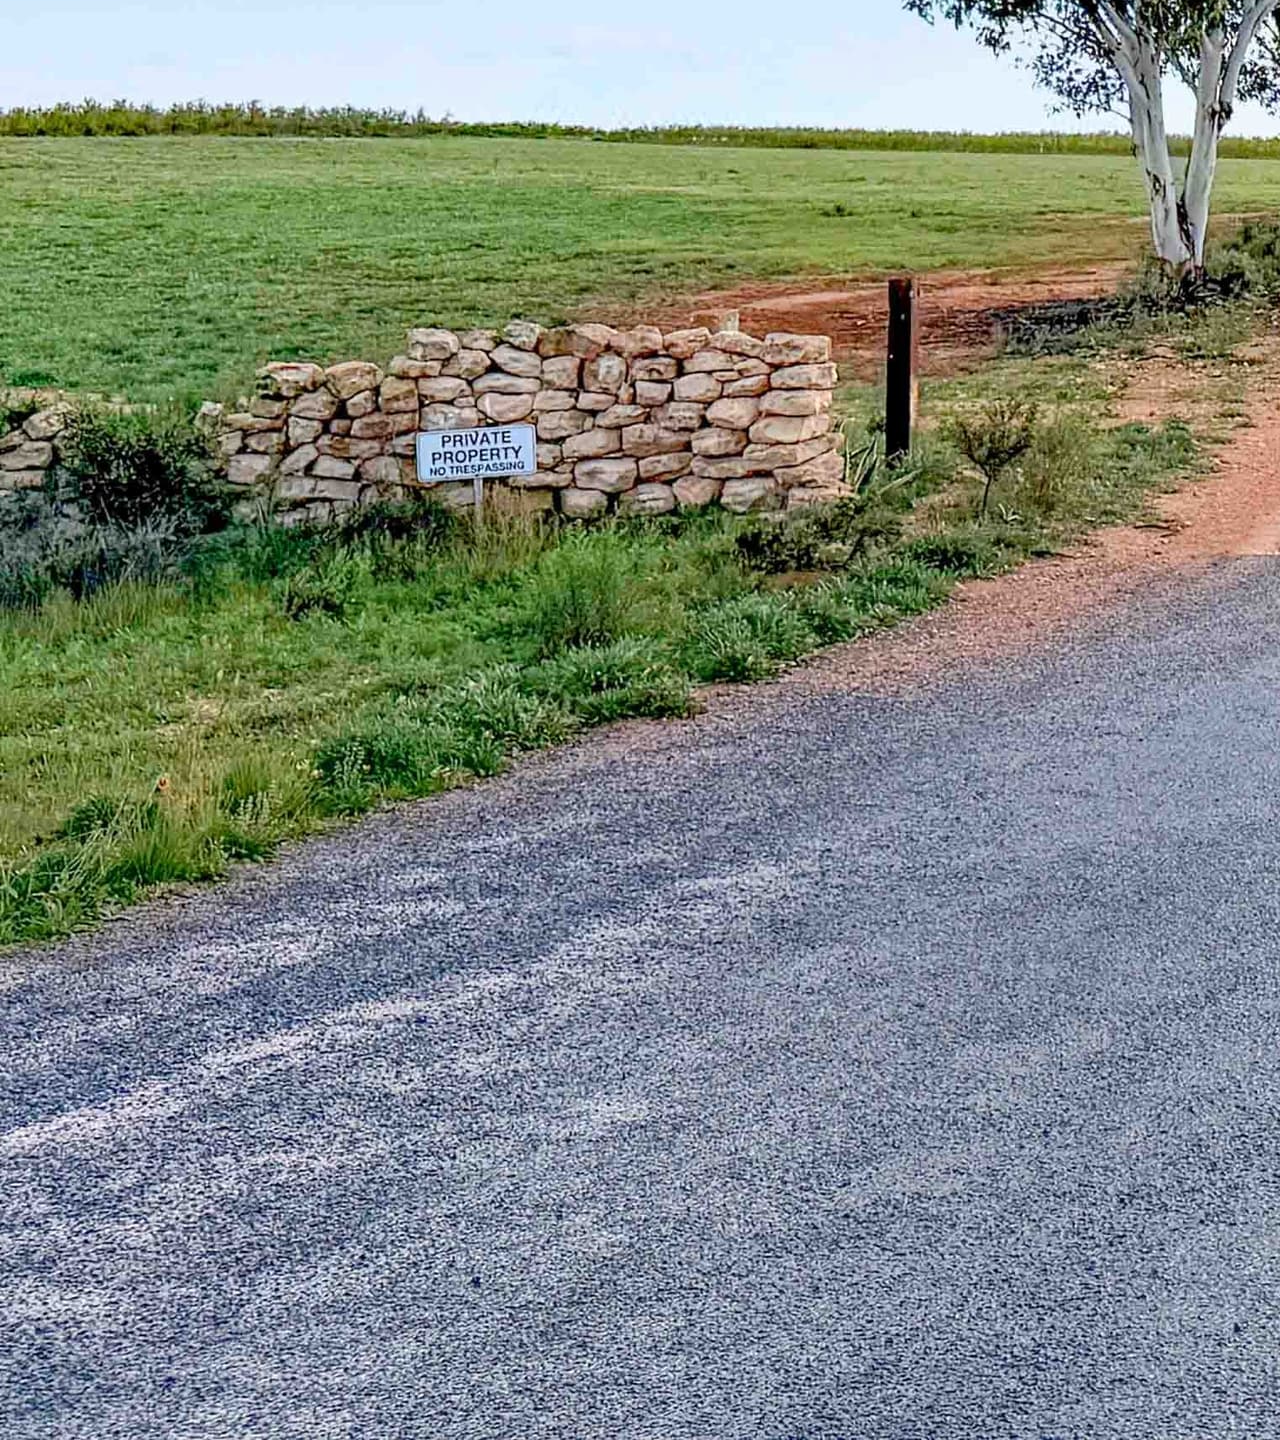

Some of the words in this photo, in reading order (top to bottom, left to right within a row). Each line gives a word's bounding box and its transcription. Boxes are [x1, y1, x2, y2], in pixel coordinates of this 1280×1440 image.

[441, 431, 511, 448] PRIVATE
[431, 445, 522, 465] PROPERTY
[430, 466, 446, 477] NO
[450, 461, 525, 474] TRESPASSING
